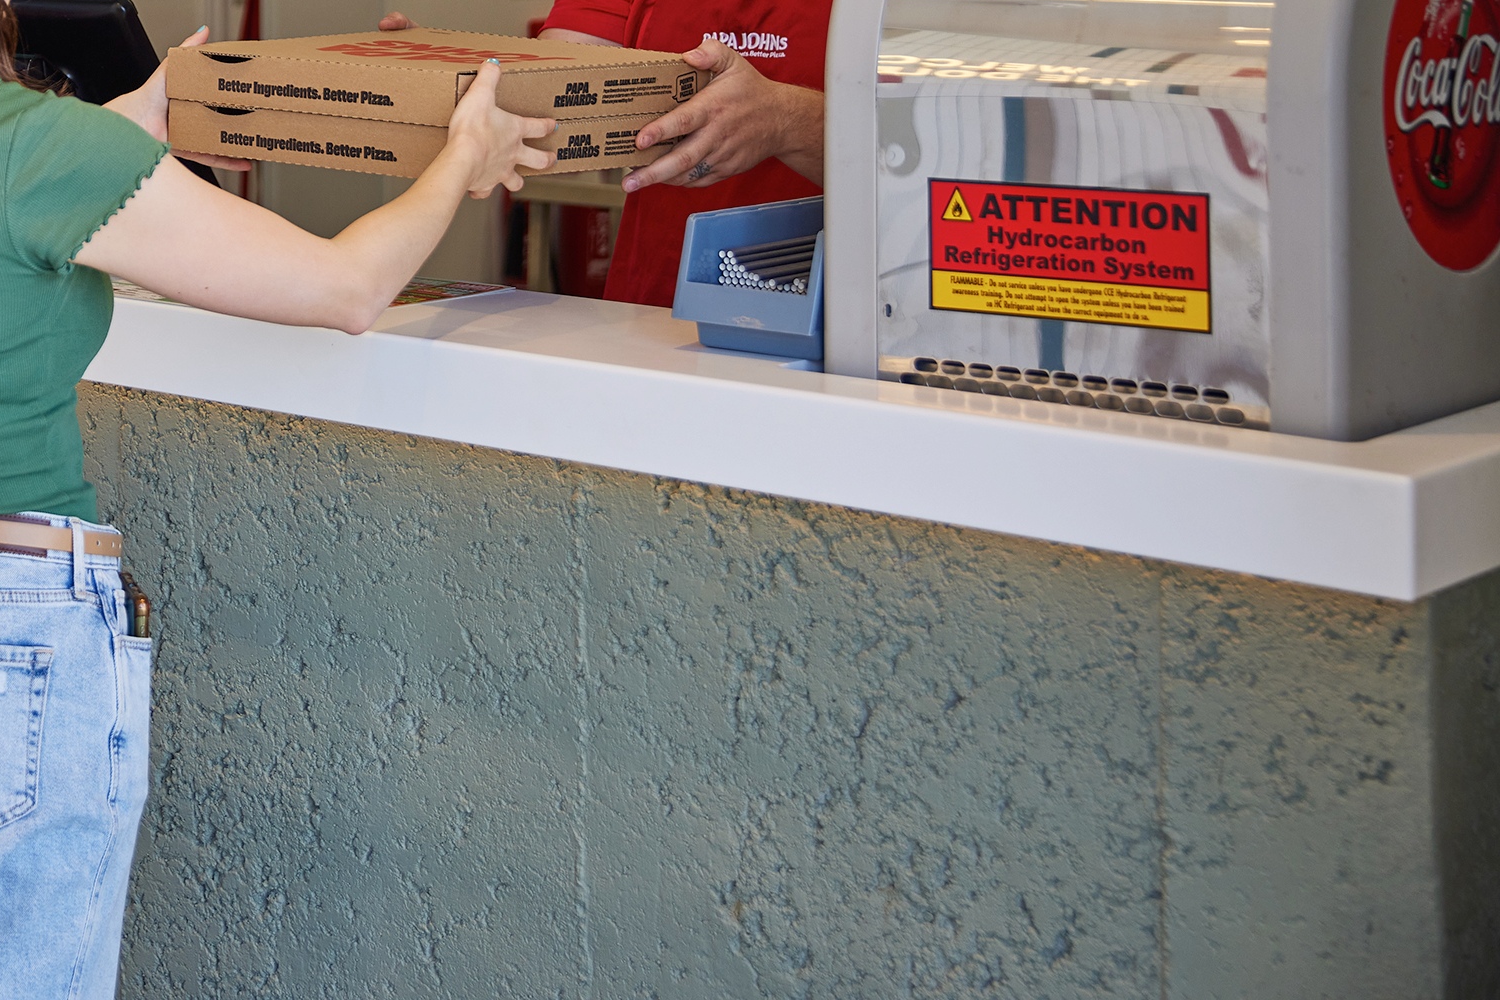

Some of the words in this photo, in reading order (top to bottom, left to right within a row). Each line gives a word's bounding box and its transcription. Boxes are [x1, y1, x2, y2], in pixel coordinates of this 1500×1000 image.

[738, 32, 788, 51] JOHNS
[218, 78, 252, 94] Better
[253, 81, 321, 100] Ingredients.
[323, 88, 359, 104] Better
[361, 91, 394, 106] Pizza.
[554, 93, 598, 108] REWARDS
[565, 82, 589, 94] PAPA
[220, 130, 254, 146] Better
[256, 134, 324, 154] Ingredients.
[326, 142, 362, 157] Better
[364, 146, 397, 162] Pizza.
[557, 145, 600, 160] REWARDS
[568, 134, 591, 147] PAPA
[979, 193, 1197, 232] ATTENTION
[987, 225, 1145, 254] Hydrocarbon
[944, 245, 1095, 273] Refrigeration
[1104, 256, 1194, 281] System
[950, 276, 983, 286] FLAMMABLE
[989, 279, 996, 287] Do
[1008, 282, 1027, 290] service
[1028, 283, 1045, 291] unless
[1058, 284, 1071, 293] have
[1073, 286, 1102, 296] undergone
[1116, 289, 1151, 300] Hydrocarbon
[1153, 292, 1186, 303] Refrigerant
[952, 288, 979, 296] awareness
[981, 290, 1003, 299] training.
[1005, 290, 1012, 298] Do
[1025, 293, 1046, 302] attempt
[1055, 296, 1068, 304] open
[1071, 296, 1079, 304] the
[1081, 298, 1100, 306] system
[1102, 299, 1120, 307] unless
[1121, 301, 1131, 309] you
[1133, 301, 1146, 310] have
[1148, 303, 1162, 311] been
[1164, 304, 1185, 313] trained
[994, 300, 1002, 308] HC
[1004, 301, 1034, 311] Refrigerant
[1048, 304, 1060, 313] have
[1062, 306, 1071, 314] the
[1073, 308, 1092, 316] correct
[1093, 310, 1123, 319] equipment
[1132, 312, 1139, 320] do
